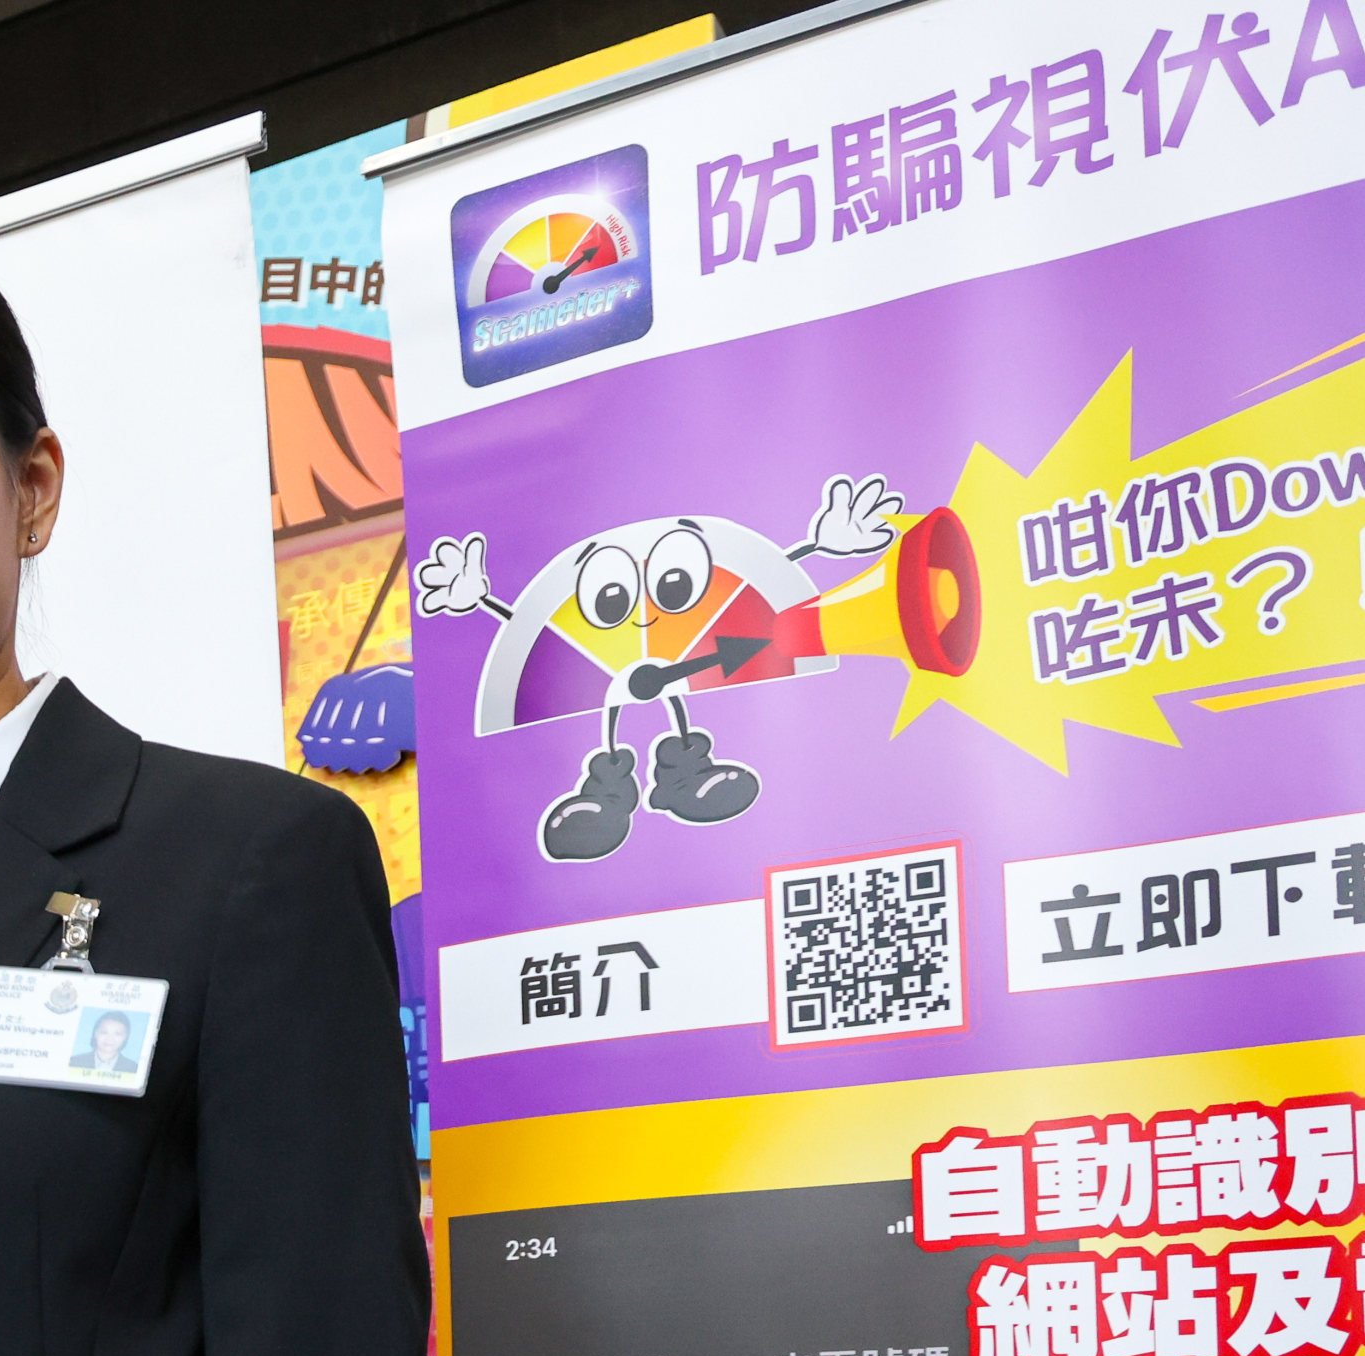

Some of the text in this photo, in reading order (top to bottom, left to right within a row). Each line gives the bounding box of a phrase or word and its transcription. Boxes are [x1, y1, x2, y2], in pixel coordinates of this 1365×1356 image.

[473, 279, 640, 353] Scameter+
[520, 940, 661, 1027] 簡介
[505, 1237, 558, 1261] 2:34
